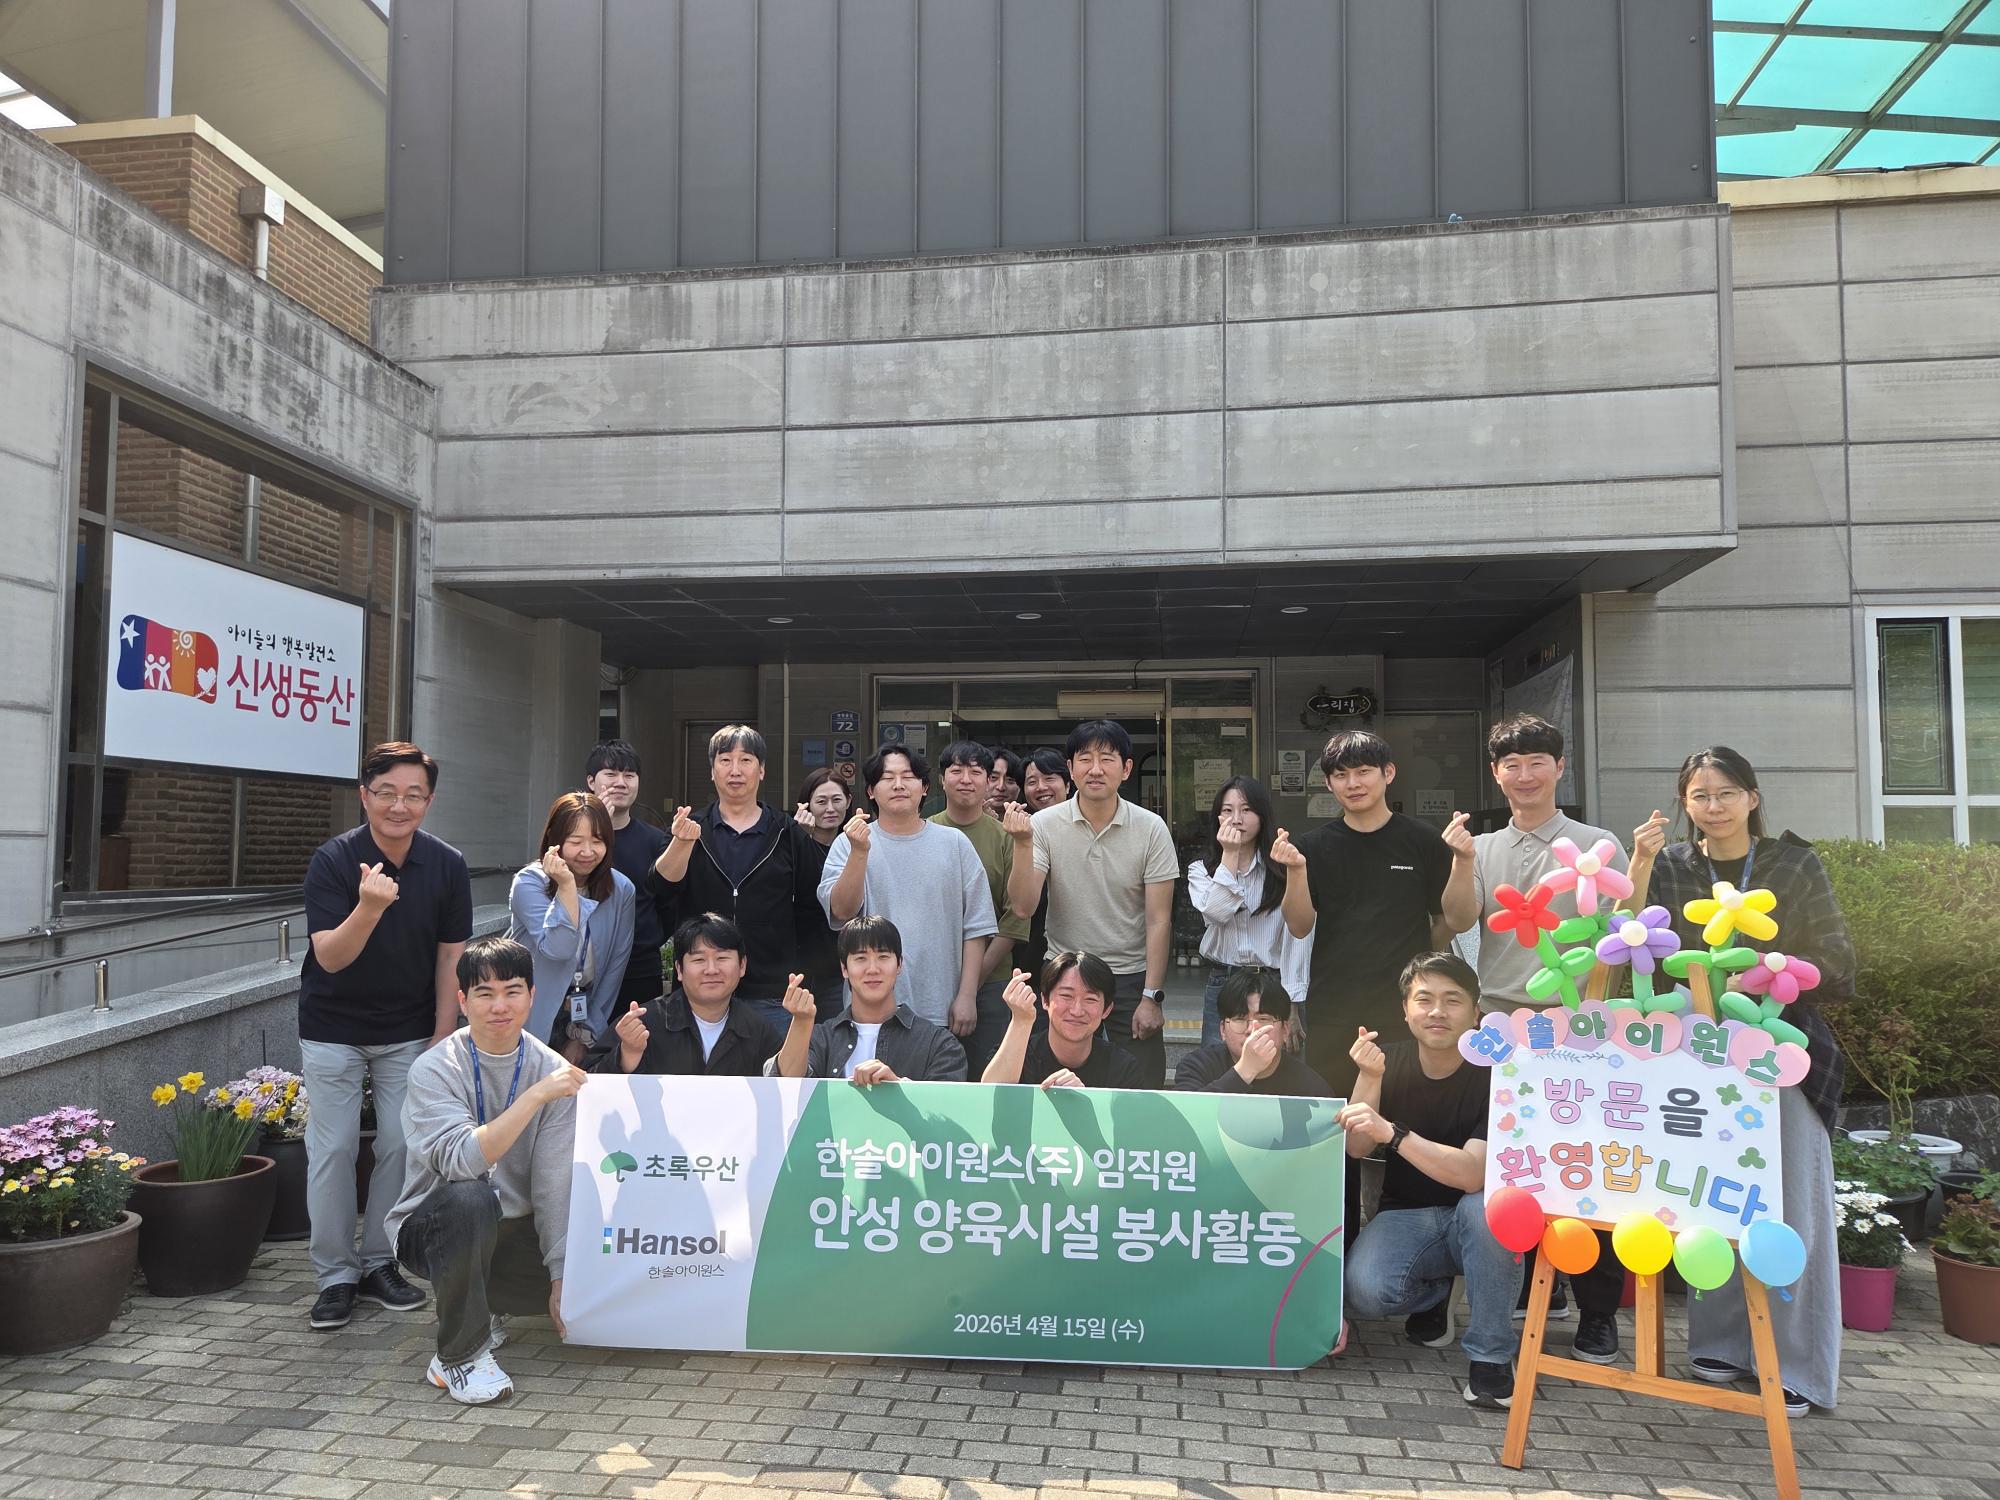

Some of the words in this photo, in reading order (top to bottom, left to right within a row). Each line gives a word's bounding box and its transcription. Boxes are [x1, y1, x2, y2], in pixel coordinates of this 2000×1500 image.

[227, 624, 276, 651] 아이들의
[226, 654, 356, 727] 신생동산
[836, 721, 854, 731] 72
[1468, 1009, 1784, 1086] 한솔아이원스
[1543, 1077, 1709, 1138] 방문을
[642, 1153, 740, 1182] 초록우산
[814, 1137, 1085, 1187] 한솔아이원스(주)
[1093, 1146, 1197, 1192] 임직원
[1496, 1140, 1769, 1227] 환영합니다
[616, 1227, 727, 1256] Hansol
[808, 1195, 901, 1252] 안성
[912, 1197, 1100, 1261] 양육시설
[1111, 1206, 1302, 1267] 봉사활동
[647, 1263, 726, 1280] 한솔아이원스
[953, 1312, 1022, 1337] 2026년
[1025, 1314, 1059, 1338] 4월
[1063, 1316, 1107, 1341] 15일
[1111, 1316, 1146, 1344] (수)
